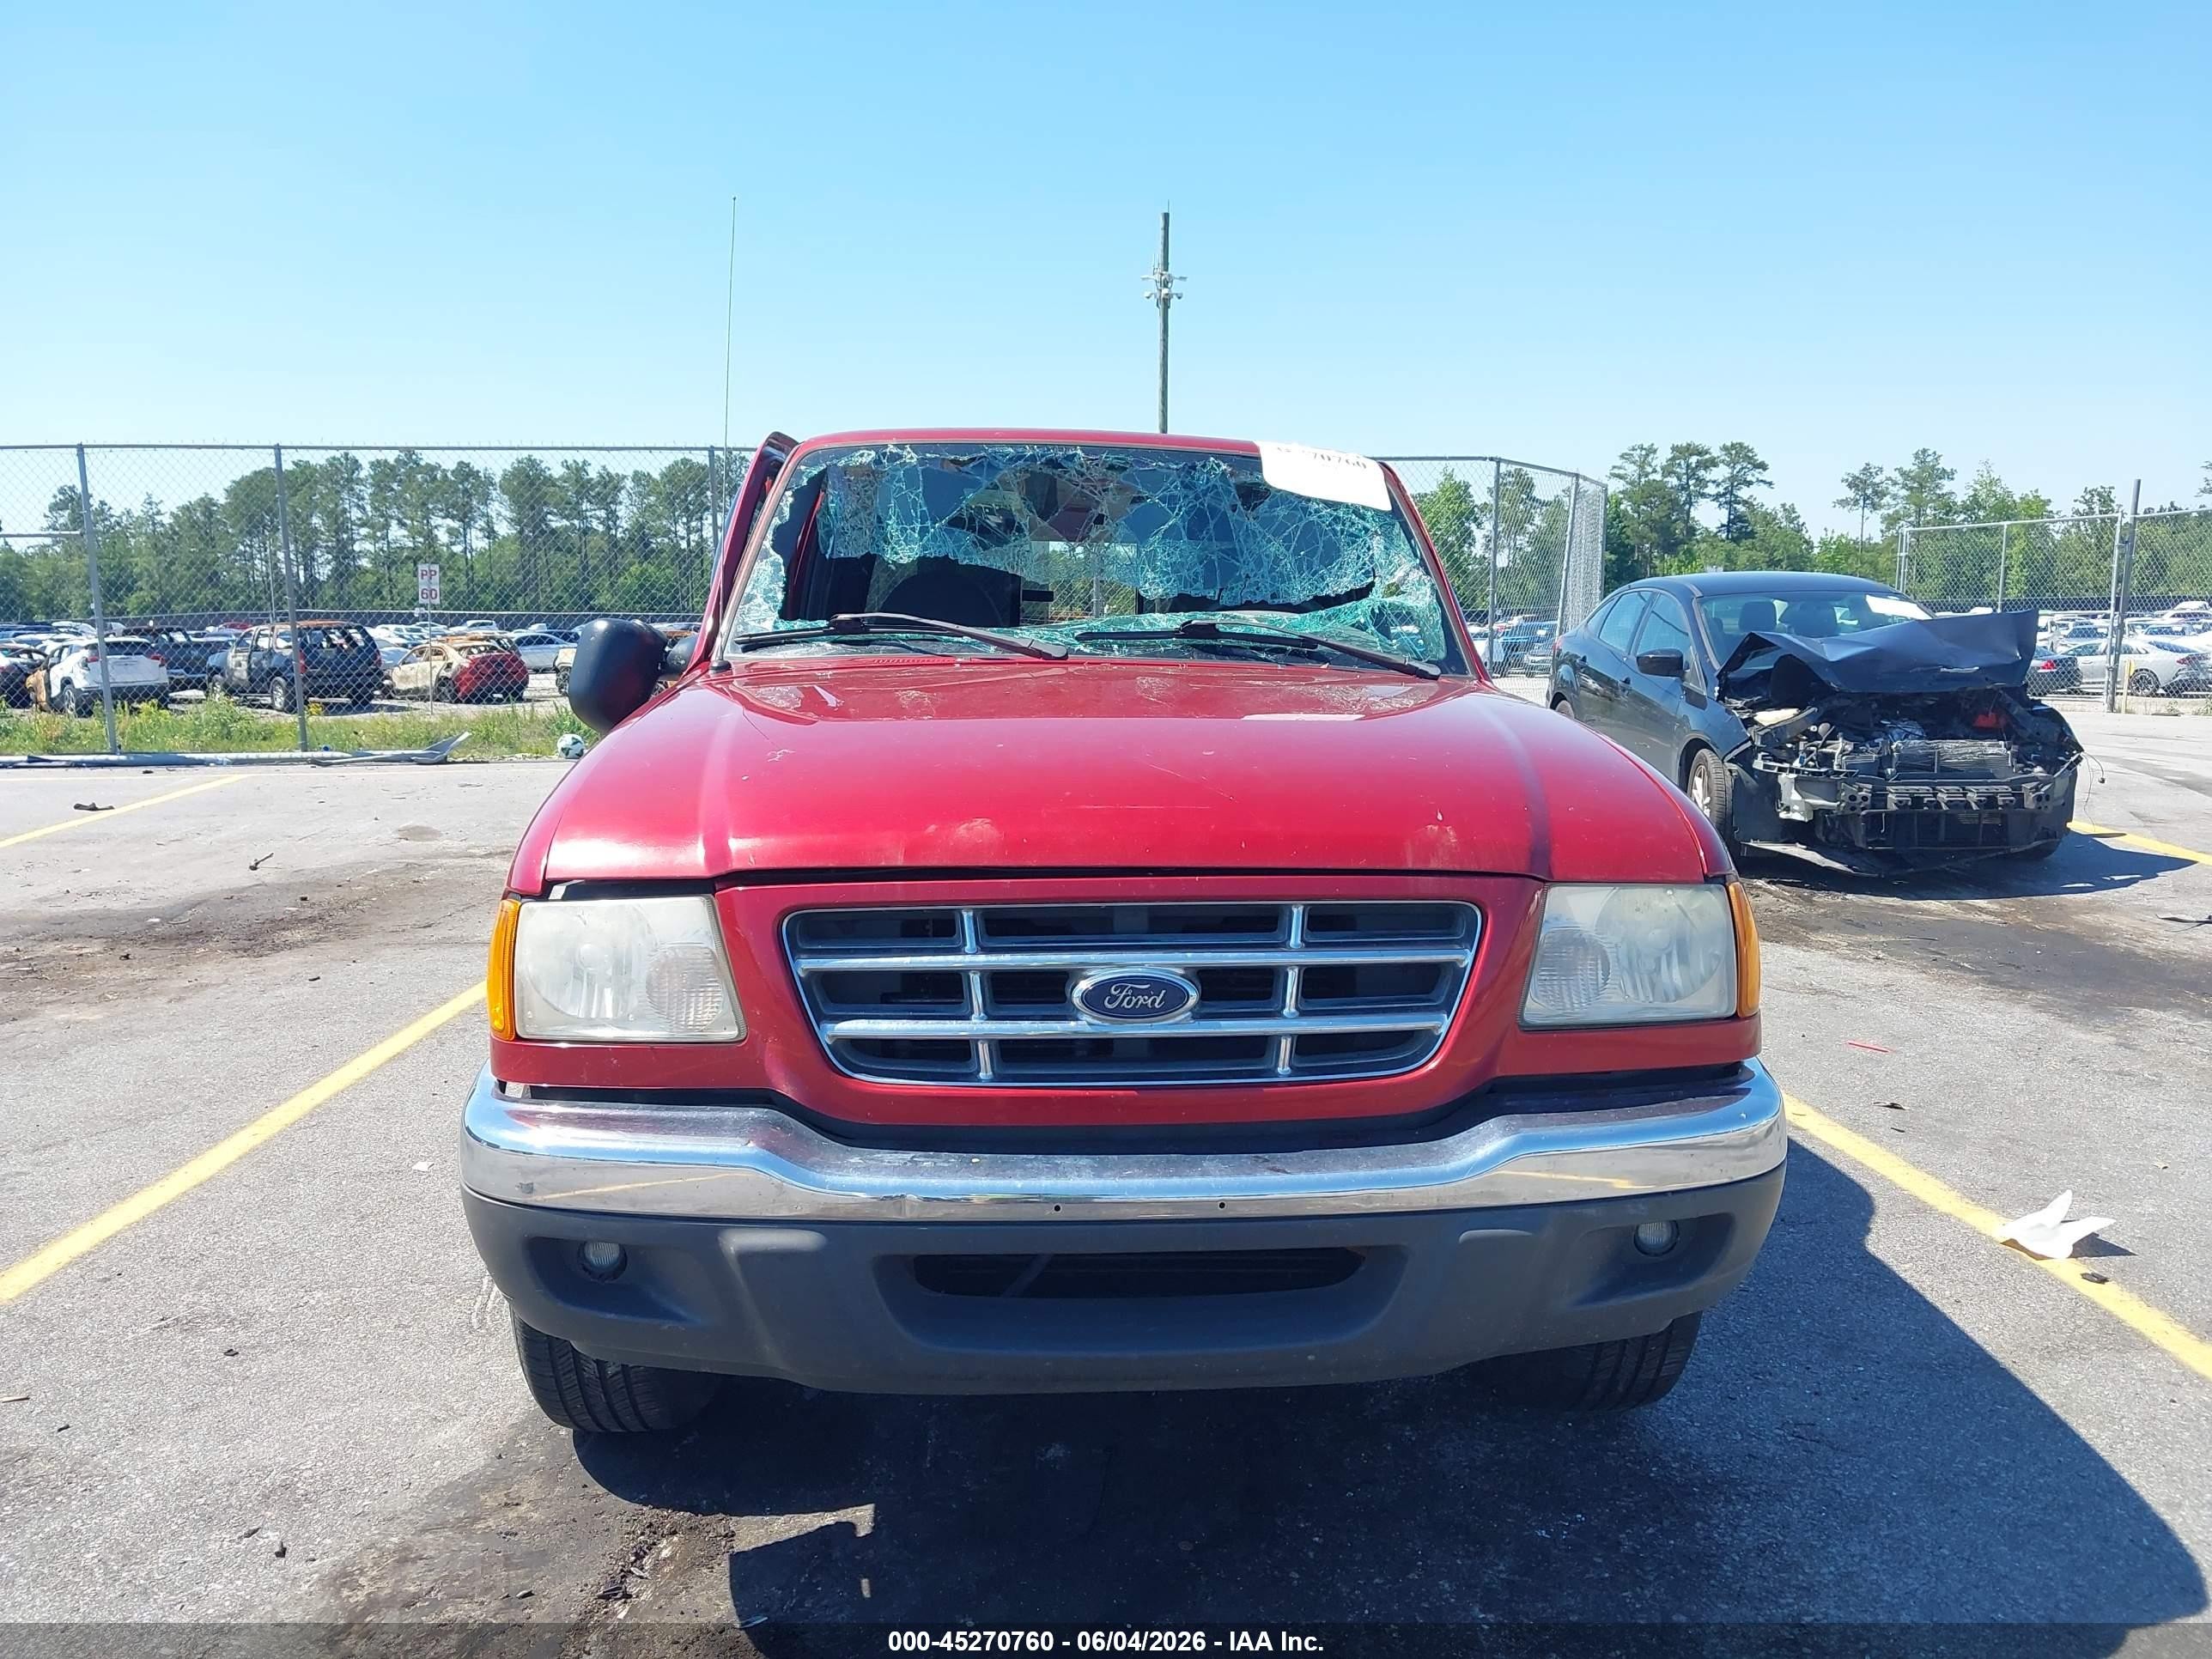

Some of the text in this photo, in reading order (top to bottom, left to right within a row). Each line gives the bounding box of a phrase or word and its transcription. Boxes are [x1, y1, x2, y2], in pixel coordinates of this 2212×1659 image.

[421, 569, 437, 580] PP
[421, 588, 438, 599] 60
[1103, 982, 1166, 1009] Ford
